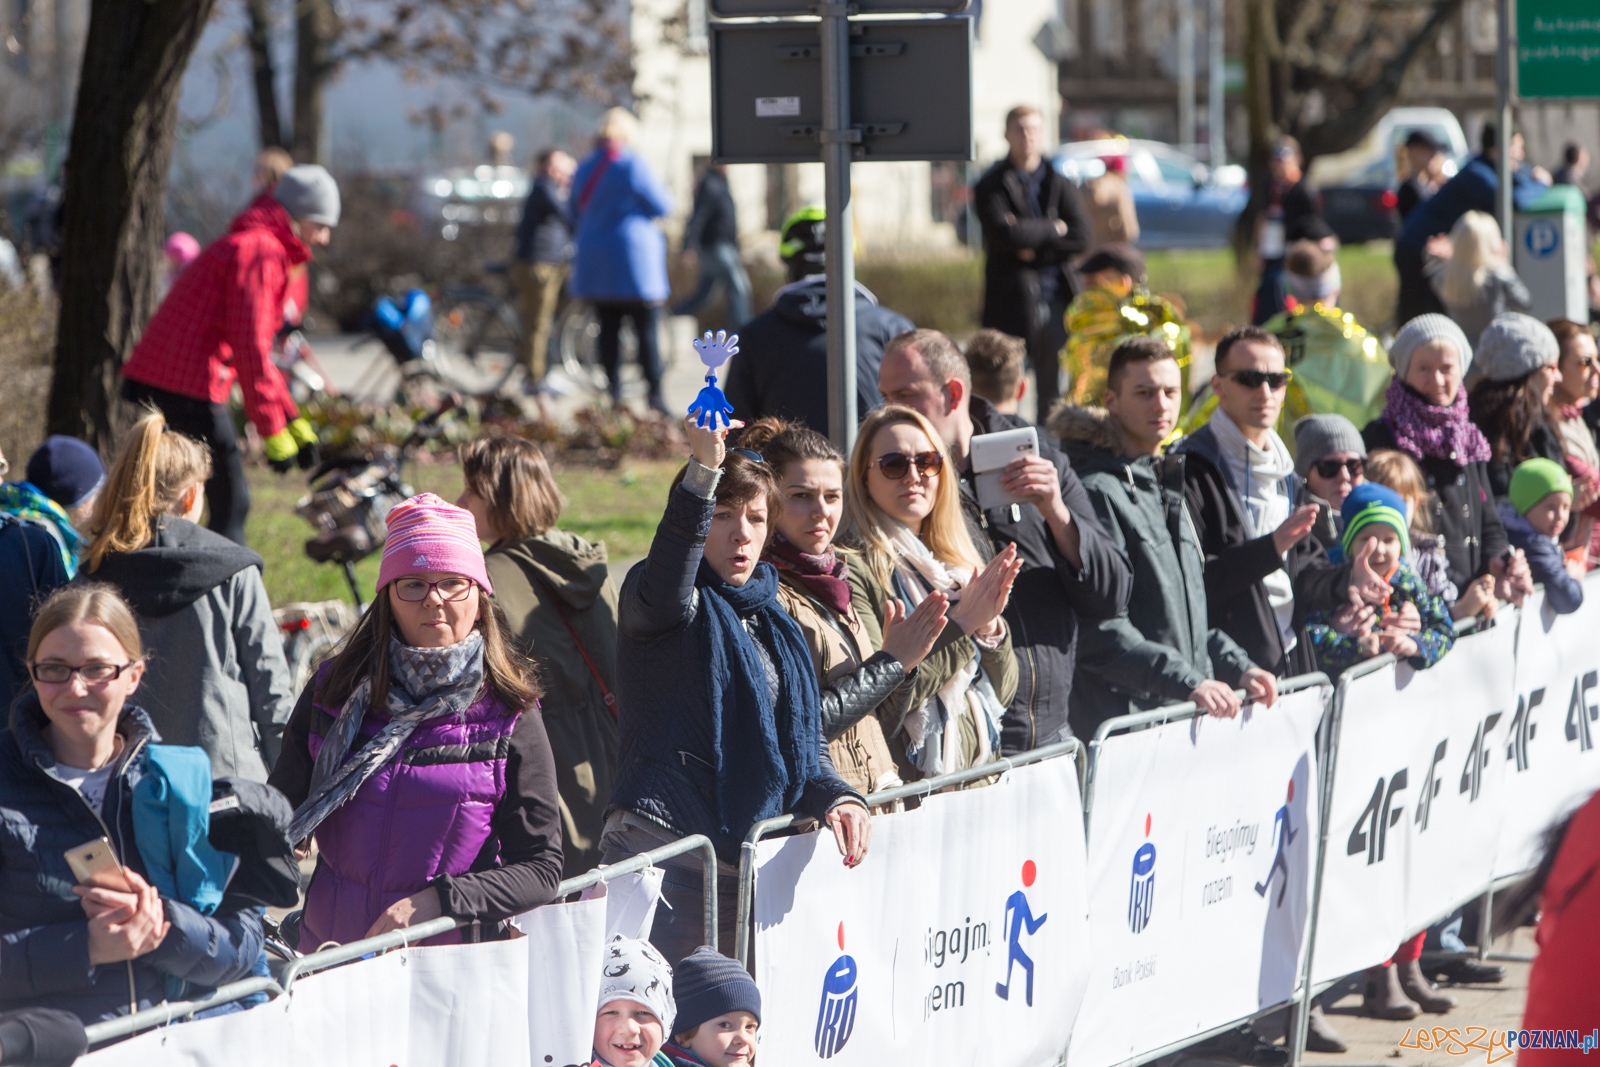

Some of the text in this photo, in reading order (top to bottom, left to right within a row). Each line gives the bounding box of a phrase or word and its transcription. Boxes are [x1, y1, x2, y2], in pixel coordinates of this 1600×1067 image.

[1532, 227, 1553, 252] P
[1505, 669, 1599, 772] 4F 4F
[1347, 712, 1503, 866] 4F 4F 4F
[1112, 953, 1158, 989] Bank Polski
